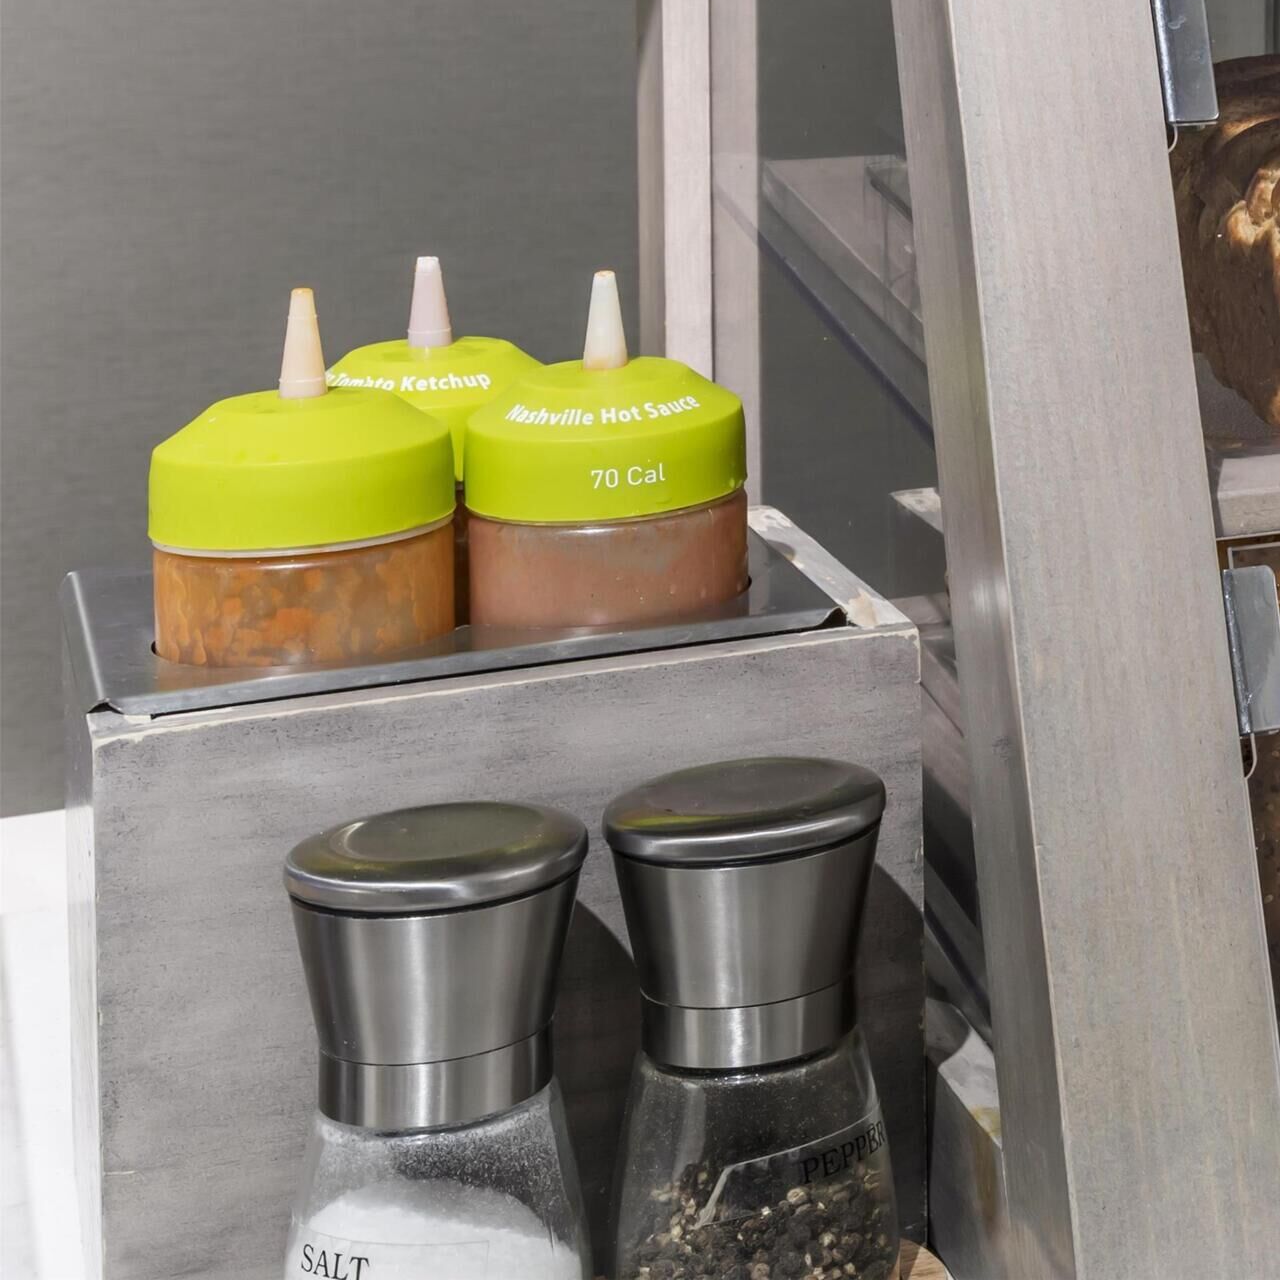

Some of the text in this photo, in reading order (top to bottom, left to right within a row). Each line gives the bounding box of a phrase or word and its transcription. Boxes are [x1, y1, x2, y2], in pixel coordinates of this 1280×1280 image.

[400, 372, 491, 392] Ketchup
[505, 395, 701, 426] Nashville Hot Sauce
[591, 463, 666, 489] 70 Cal
[301, 1244, 370, 1280] SALT
